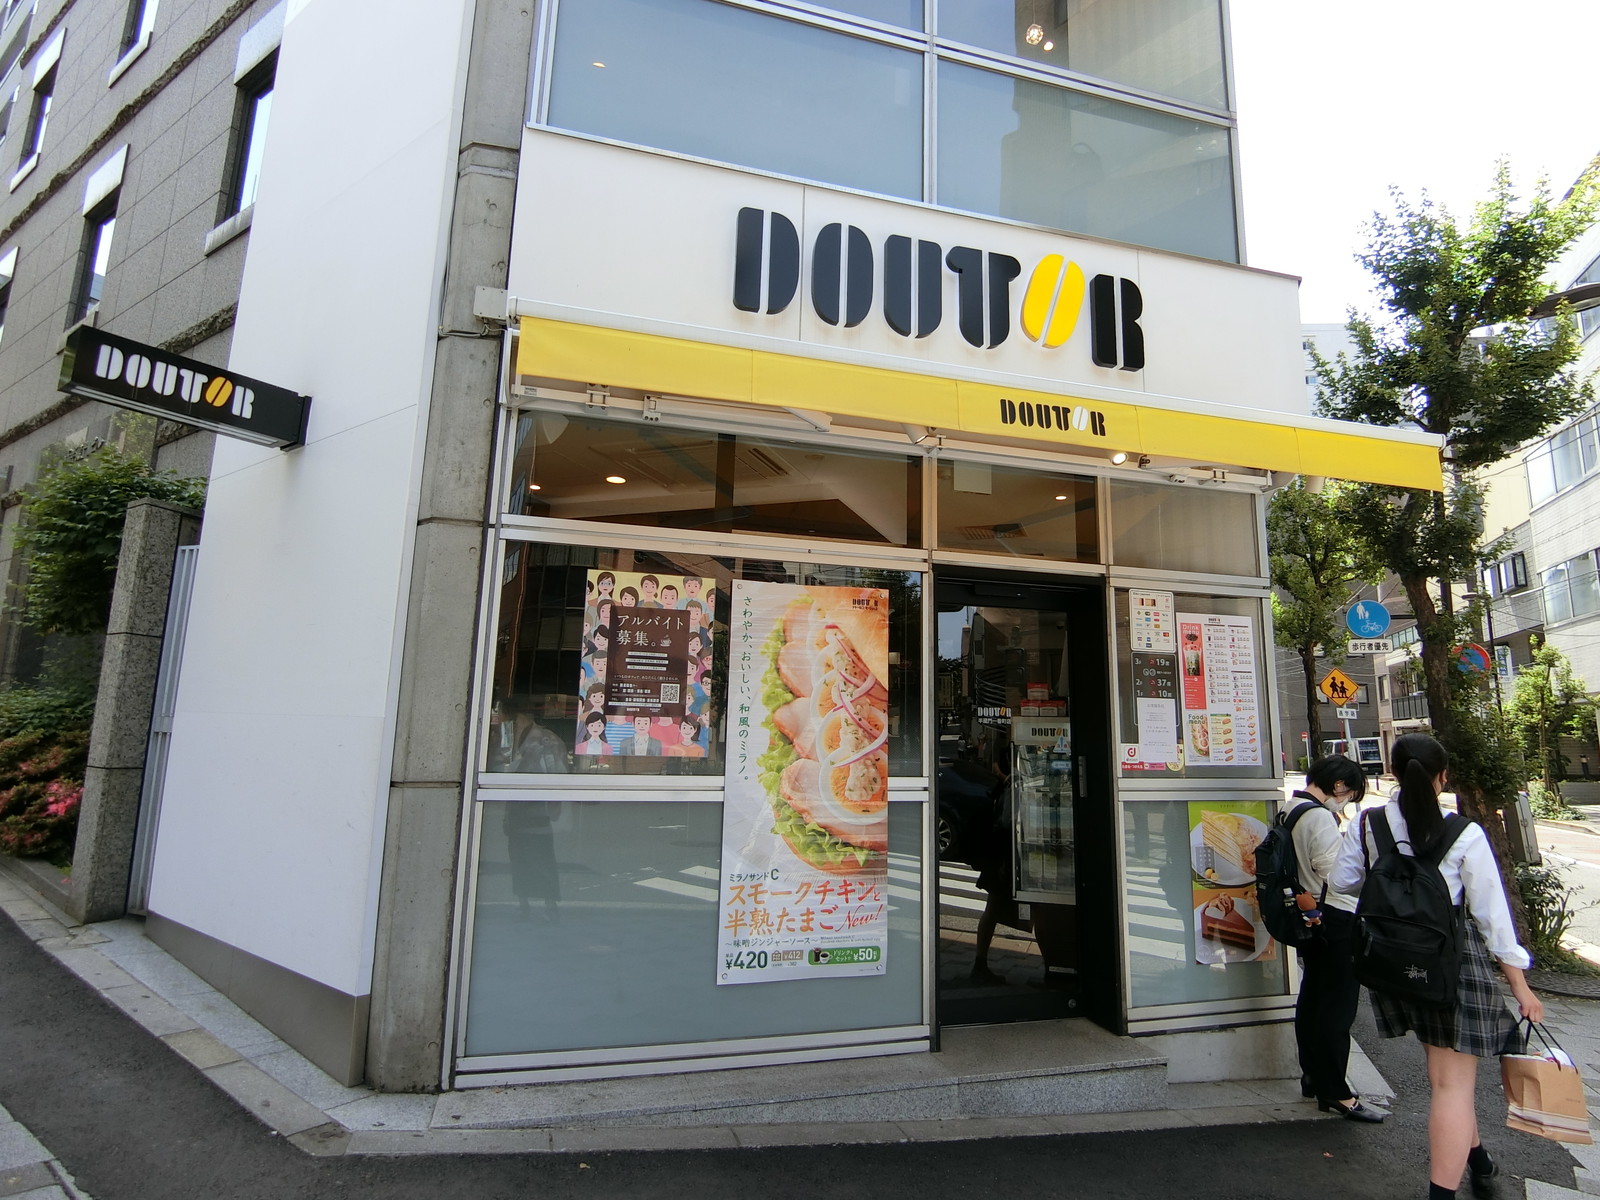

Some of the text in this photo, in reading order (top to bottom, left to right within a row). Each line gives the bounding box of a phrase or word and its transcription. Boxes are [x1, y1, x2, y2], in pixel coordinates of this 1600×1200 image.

[733, 206, 1145, 372] DOUTOR
[95, 343, 255, 419] DOUTOR
[1000, 398, 1106, 437] DOUTOR
[616, 614, 685, 631] アルバイト
[615, 629, 657, 648] 募集。
[1351, 641, 1390, 651] 歩行者優先
[737, 595, 753, 781] さわやか、おいしい、和風のミラノ。
[977, 706, 1012, 718] DOUTOR
[726, 879, 881, 907] スモークチキンと
[724, 903, 884, 938] 半熟たまご New!
[725, 950, 768, 970] ¥420
